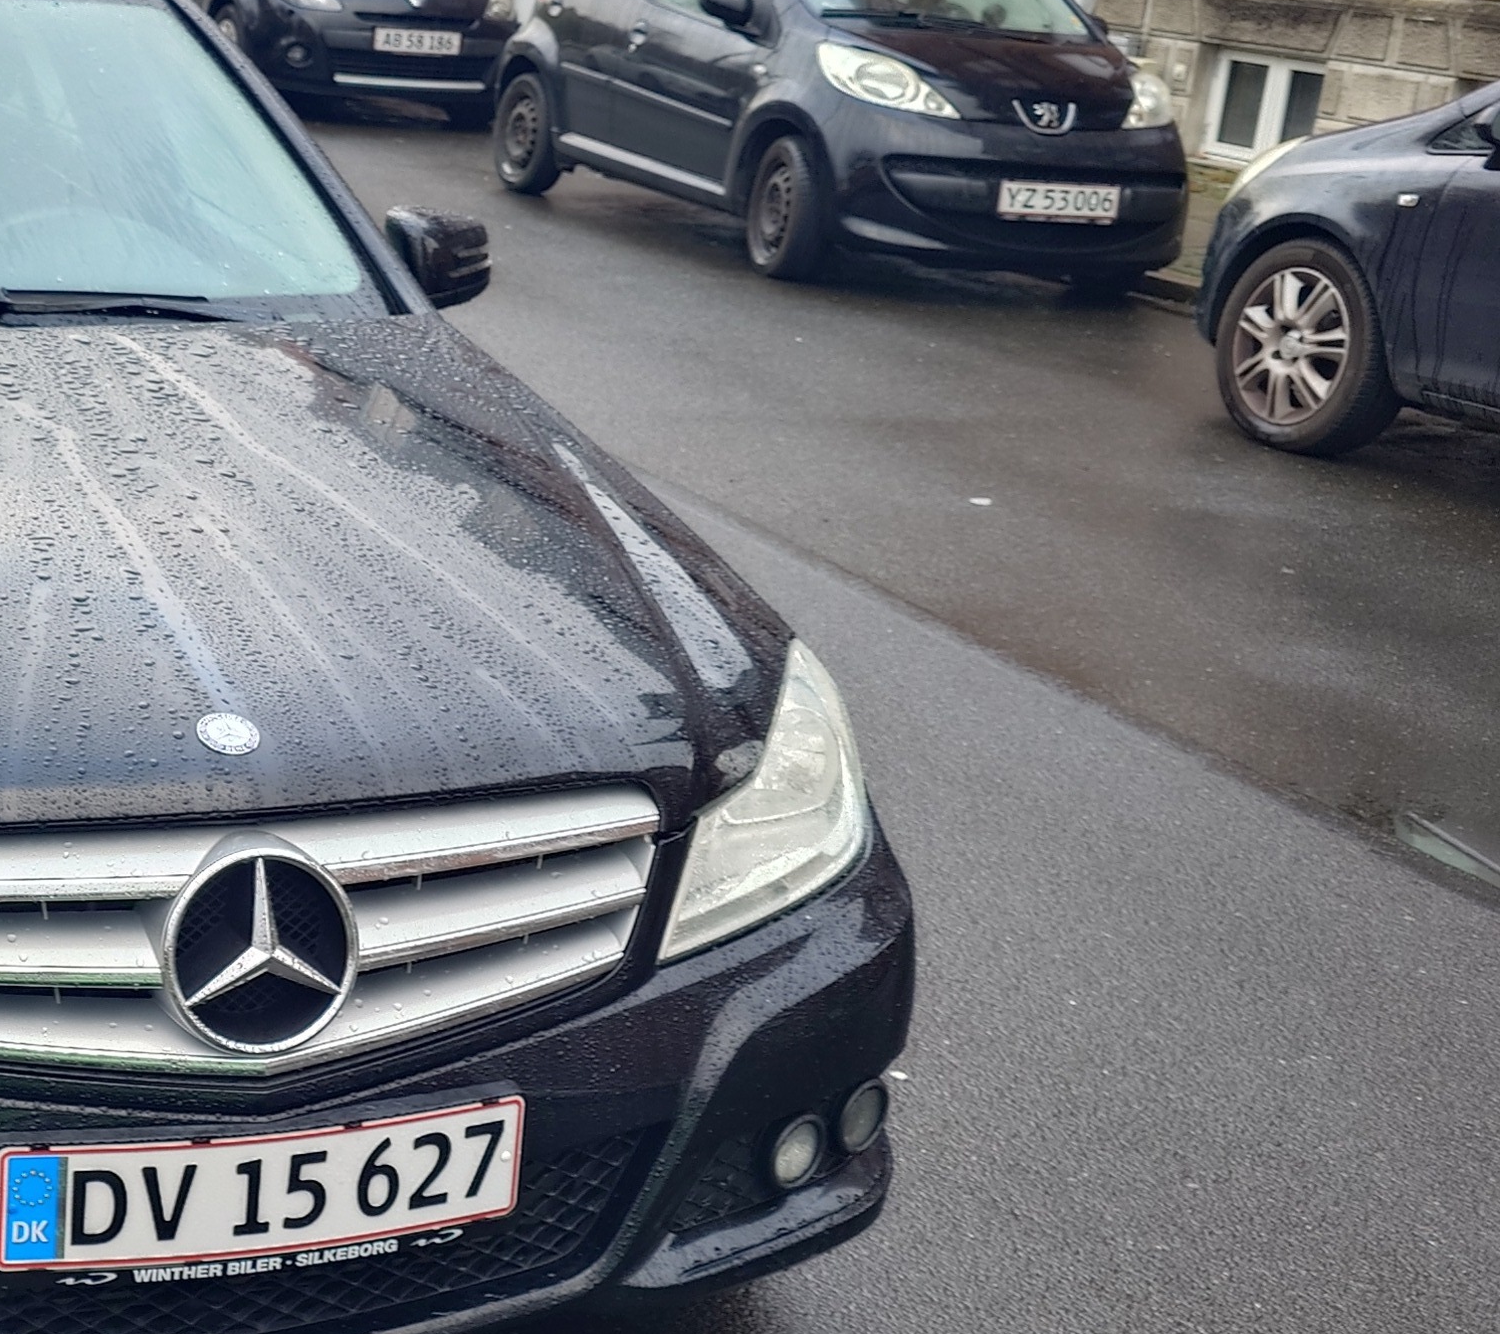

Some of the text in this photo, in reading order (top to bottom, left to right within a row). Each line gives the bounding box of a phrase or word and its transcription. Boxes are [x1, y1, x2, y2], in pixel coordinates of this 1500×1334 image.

[1007, 187, 1113, 213] YZ 53 006
[71, 1120, 505, 1246] DV 15 627
[11, 1220, 49, 1244] DK
[132, 1263, 224, 1284] WINTHER
[226, 1257, 283, 1277] BILER
[295, 1239, 399, 1267] SILKEBORG
